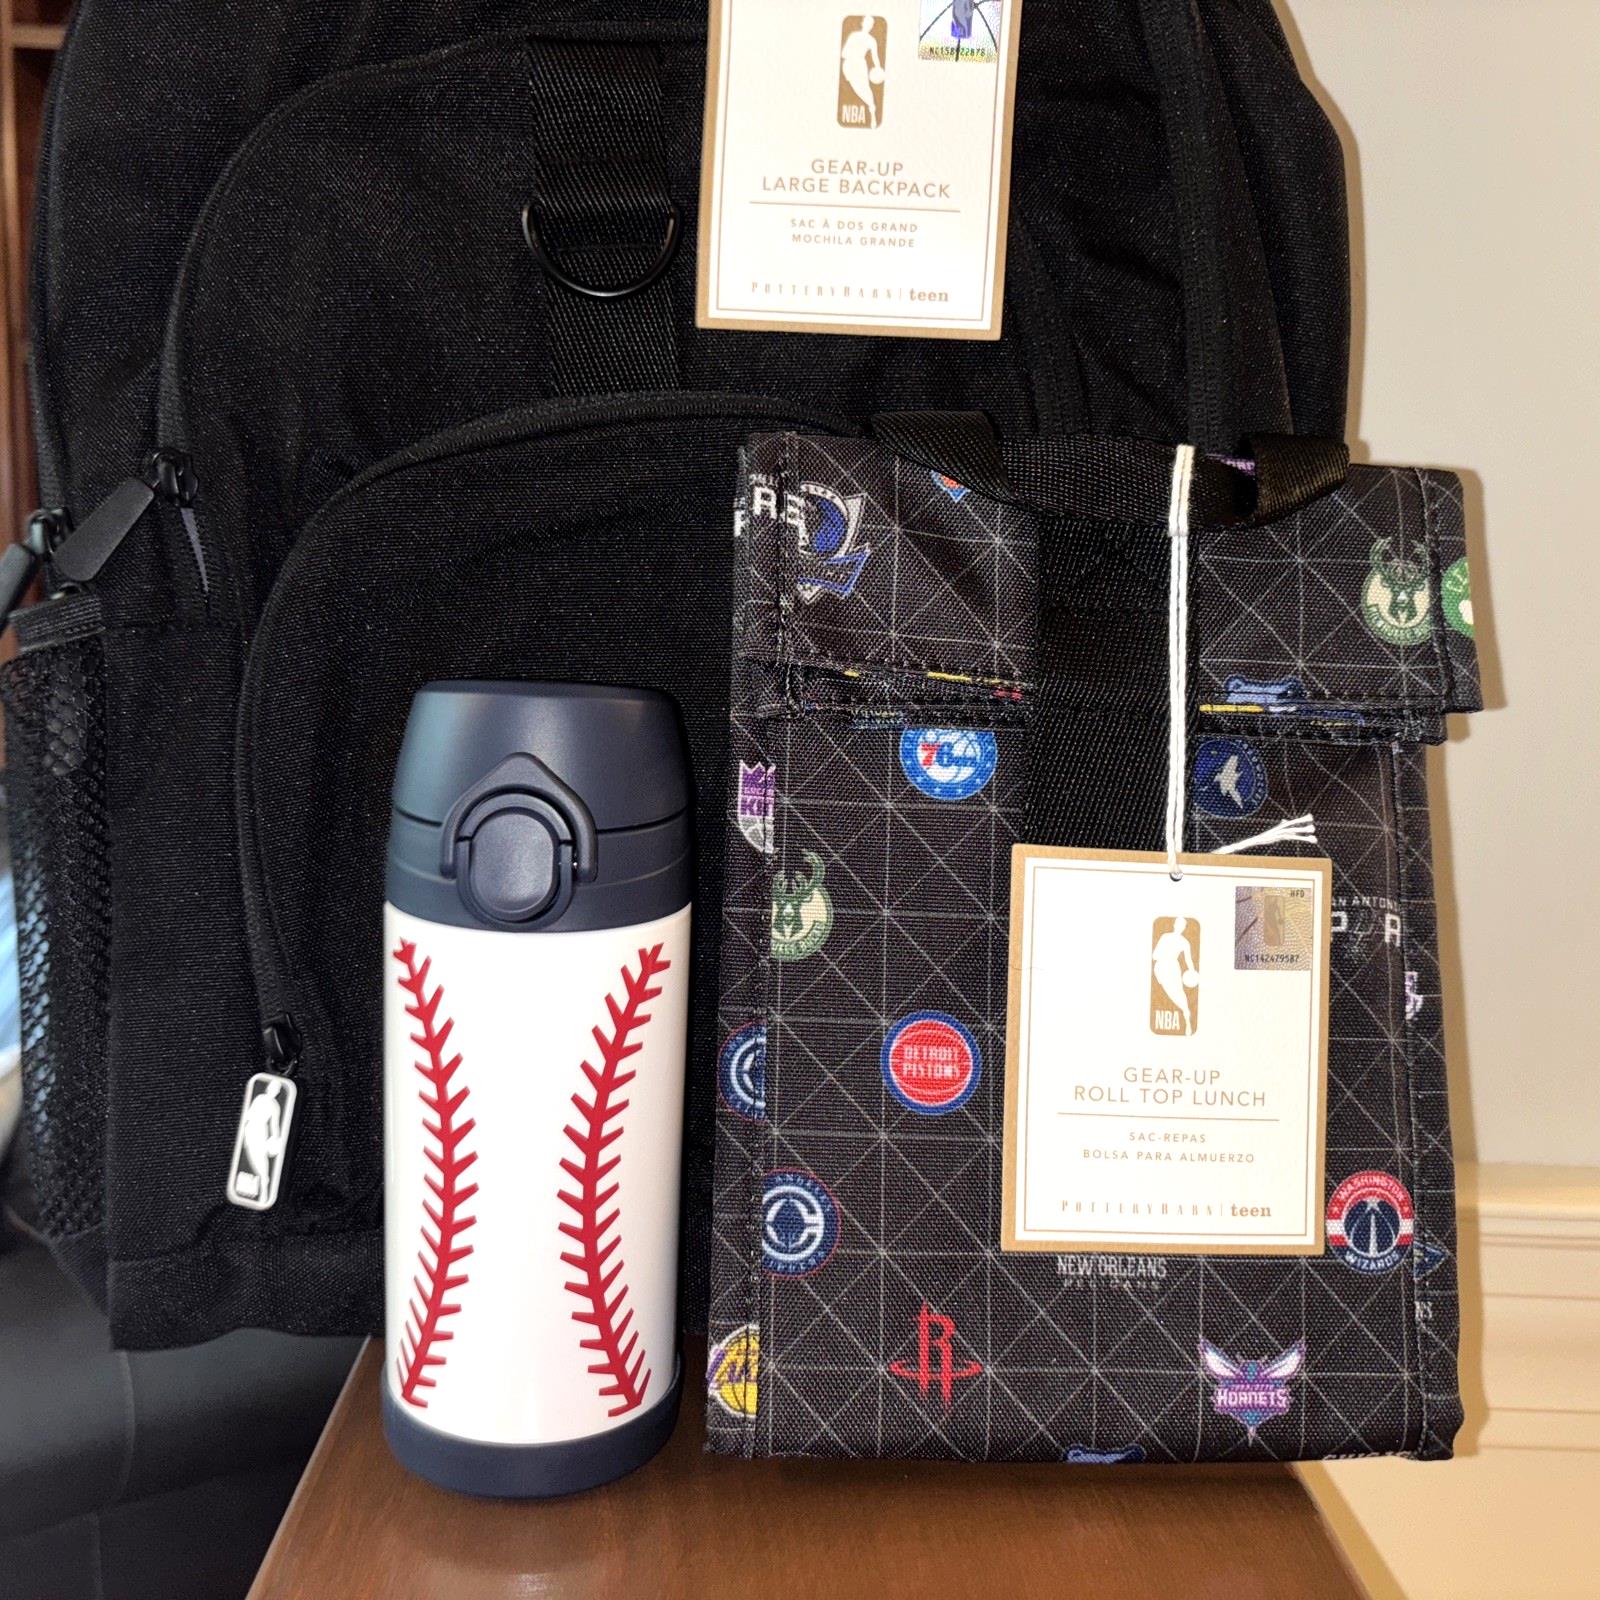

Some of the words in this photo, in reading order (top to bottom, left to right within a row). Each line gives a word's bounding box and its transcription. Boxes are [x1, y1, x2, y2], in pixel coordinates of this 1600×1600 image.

[842, 104, 867, 124] NBA
[811, 158, 905, 178] GEAR-UP
[762, 176, 830, 194] LARGE
[839, 179, 951, 199] BACKPACK
[791, 218, 817, 230] SAC
[822, 216, 831, 230] À
[837, 220, 865, 232] DOS
[871, 221, 918, 234] GRAND
[791, 233, 853, 246] MOCHILA
[859, 235, 915, 249] GRANDE
[908, 288, 949, 303] teen
[1154, 1009, 1181, 1031] NBA
[1123, 1066, 1221, 1086] GEAR-UP
[1074, 1085, 1130, 1103] ROLL
[1139, 1088, 1183, 1105] TOP
[1193, 1090, 1266, 1107] LUNCH
[1129, 1131, 1207, 1144] SAC-REPAS
[1083, 1149, 1129, 1160] BOLSA
[1137, 1151, 1172, 1162] PARA
[1180, 1152, 1255, 1164] ALMUERZO
[1336, 1175, 1405, 1201] WASHINGTON
[1230, 1203, 1272, 1218] teen
[1057, 1254, 1093, 1275] NEW
[1099, 1255, 1167, 1278] ORLEANS
[1344, 1250, 1400, 1270] WIZARDS
[1215, 1388, 1288, 1408] HORNETS
